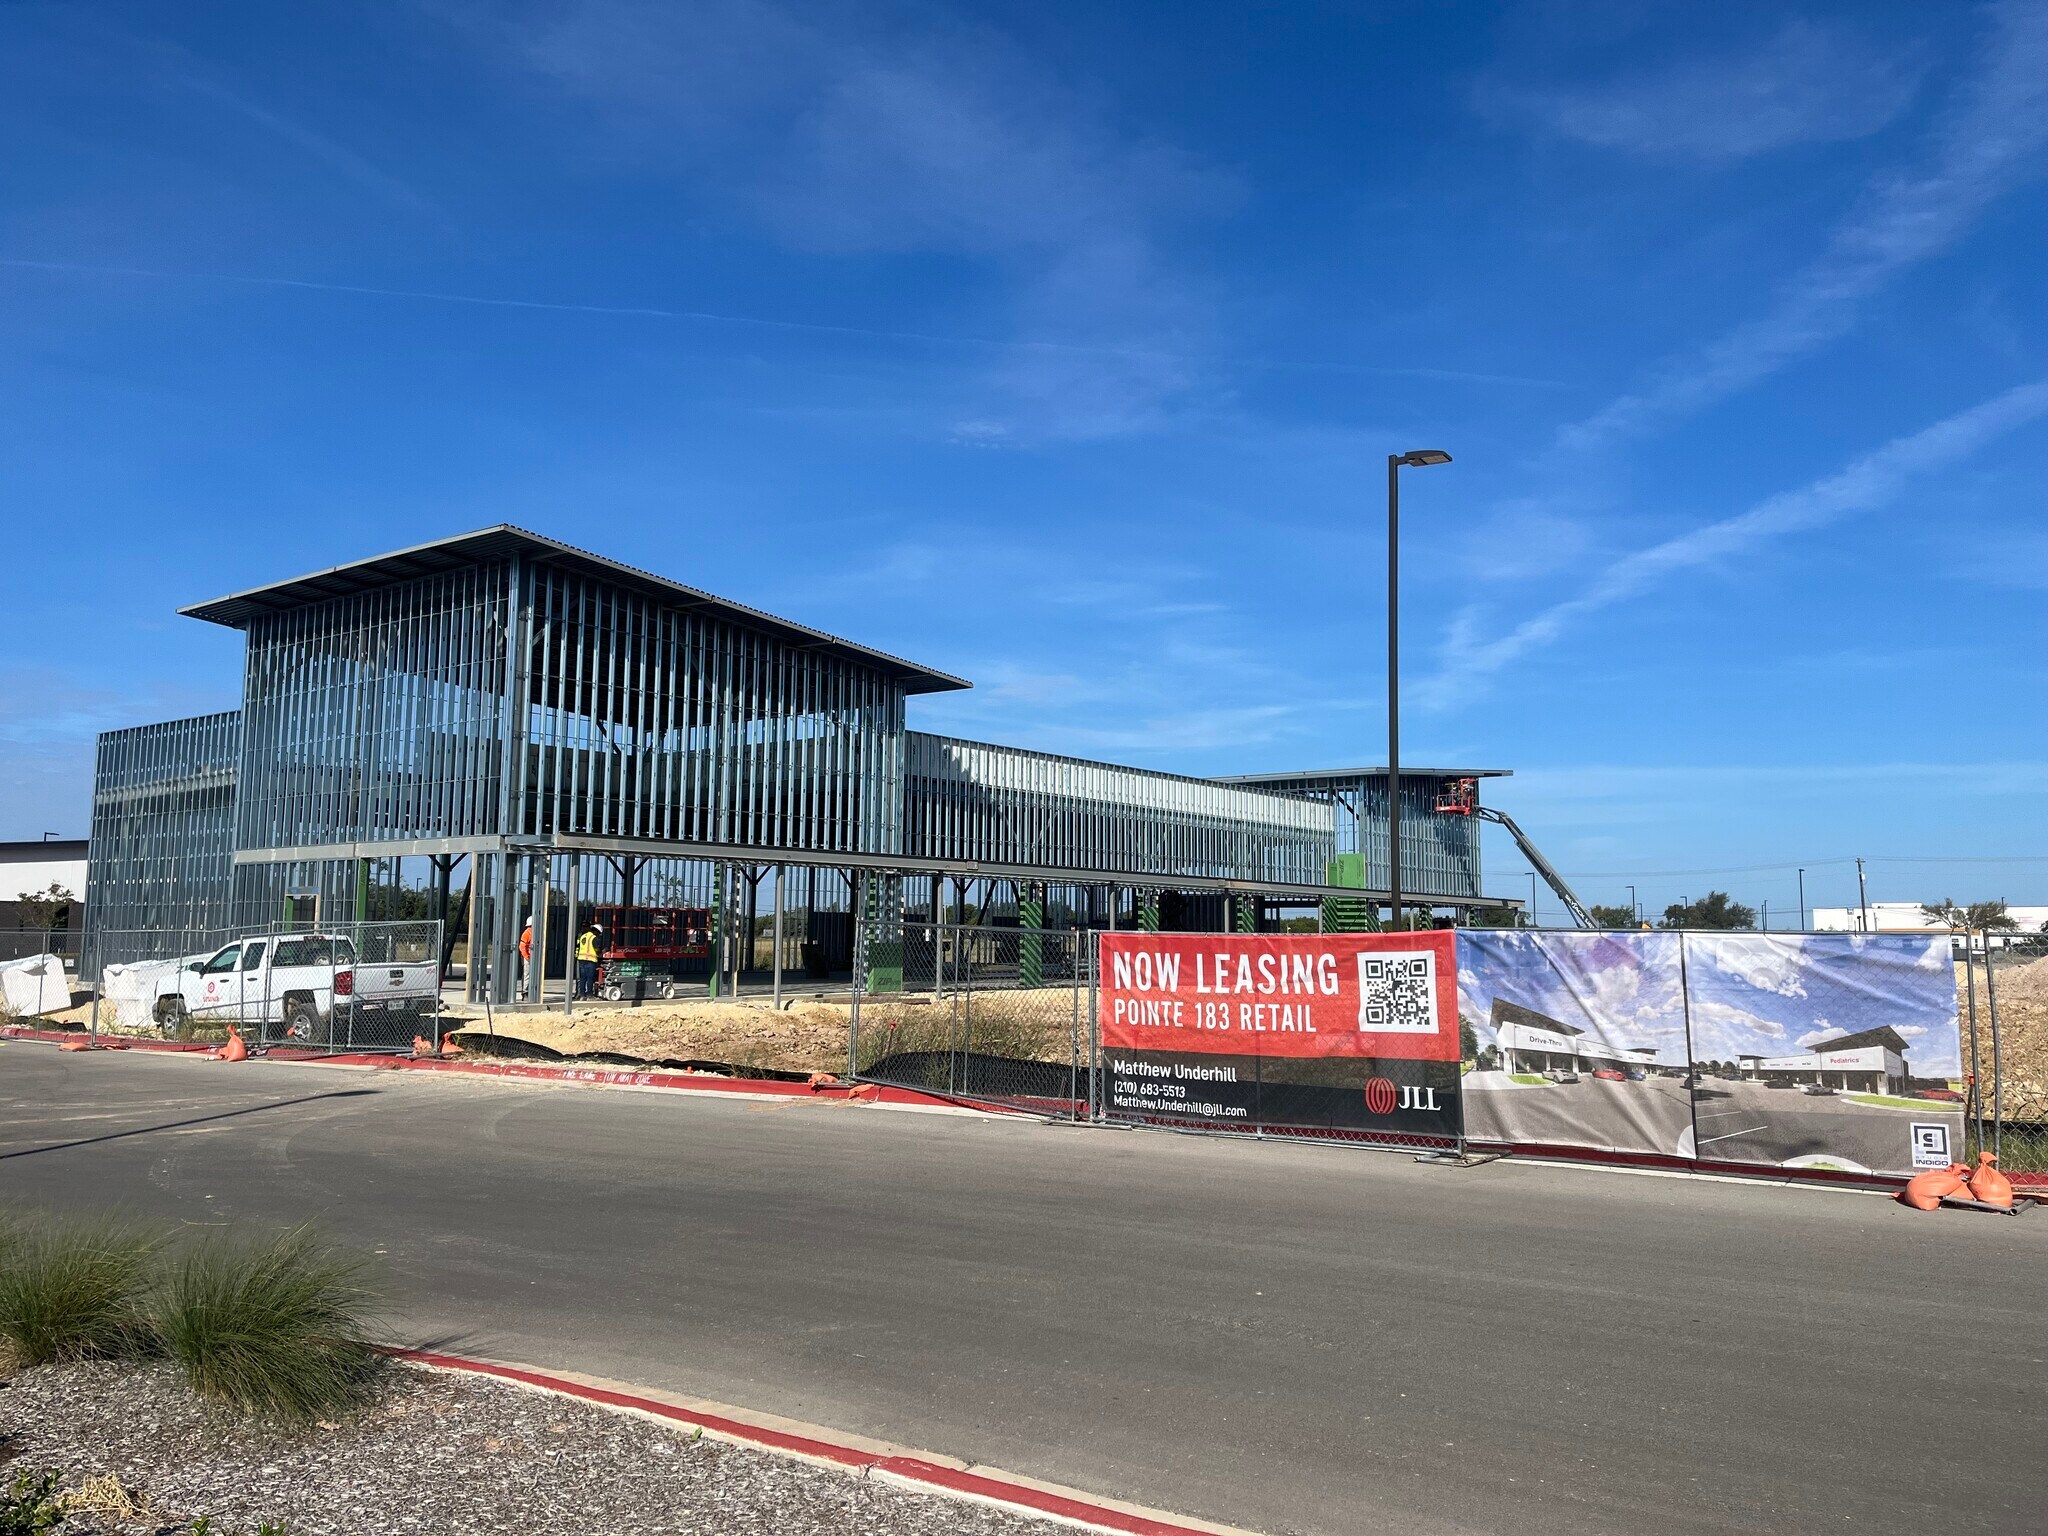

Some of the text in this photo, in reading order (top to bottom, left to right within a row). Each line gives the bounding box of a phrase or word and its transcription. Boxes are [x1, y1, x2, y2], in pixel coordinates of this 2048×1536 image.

[1113, 951, 1340, 996] NOW LEASING
[1114, 998, 1317, 1033] POINTE 183 RETAIL
[1529, 1035, 1563, 1047] Drive-Thru
[1113, 1060, 1237, 1083] Matthew Underhill
[1113, 1081, 1186, 1098] (210) 683-5513
[1398, 1086, 1442, 1112] JLL
[1113, 1095, 1247, 1118] Matthew.Underhill@jll.com
